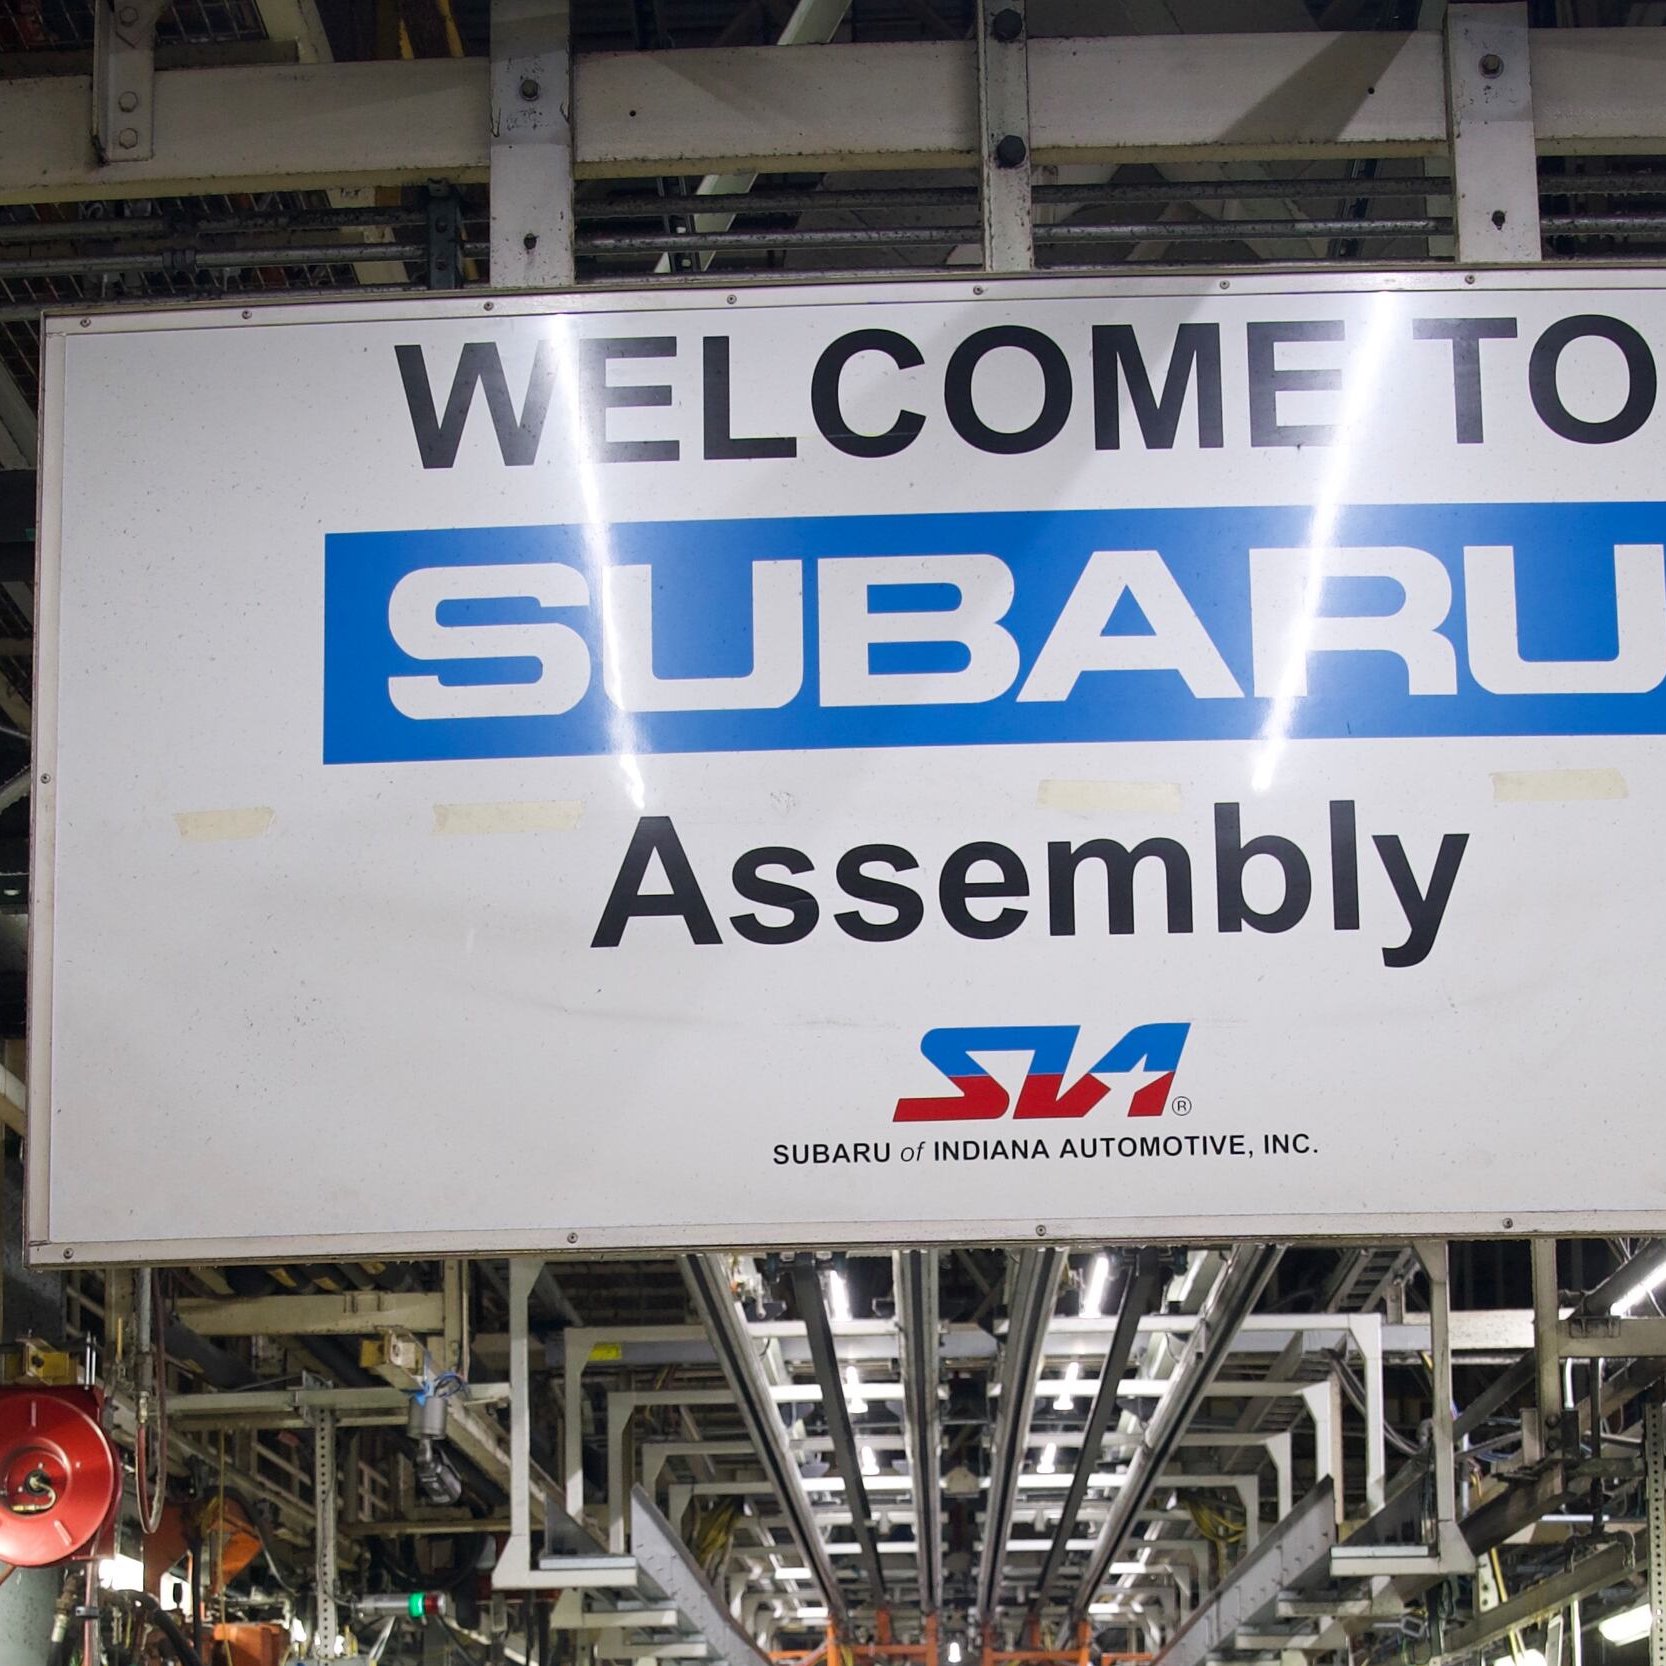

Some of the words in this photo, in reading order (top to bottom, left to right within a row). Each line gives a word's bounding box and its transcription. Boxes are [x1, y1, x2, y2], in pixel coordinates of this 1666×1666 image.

[395, 319, 1351, 469] WELCOME
[1414, 315, 1658, 445] TO
[591, 801, 1470, 968] Assembly
[773, 1142, 891, 1165] SUBARU
[900, 1141, 926, 1163] of
[934, 1140, 1050, 1161] INDIANA
[1059, 1134, 1251, 1160] AUTOMOTIVE,
[1264, 1133, 1319, 1154] INC.
